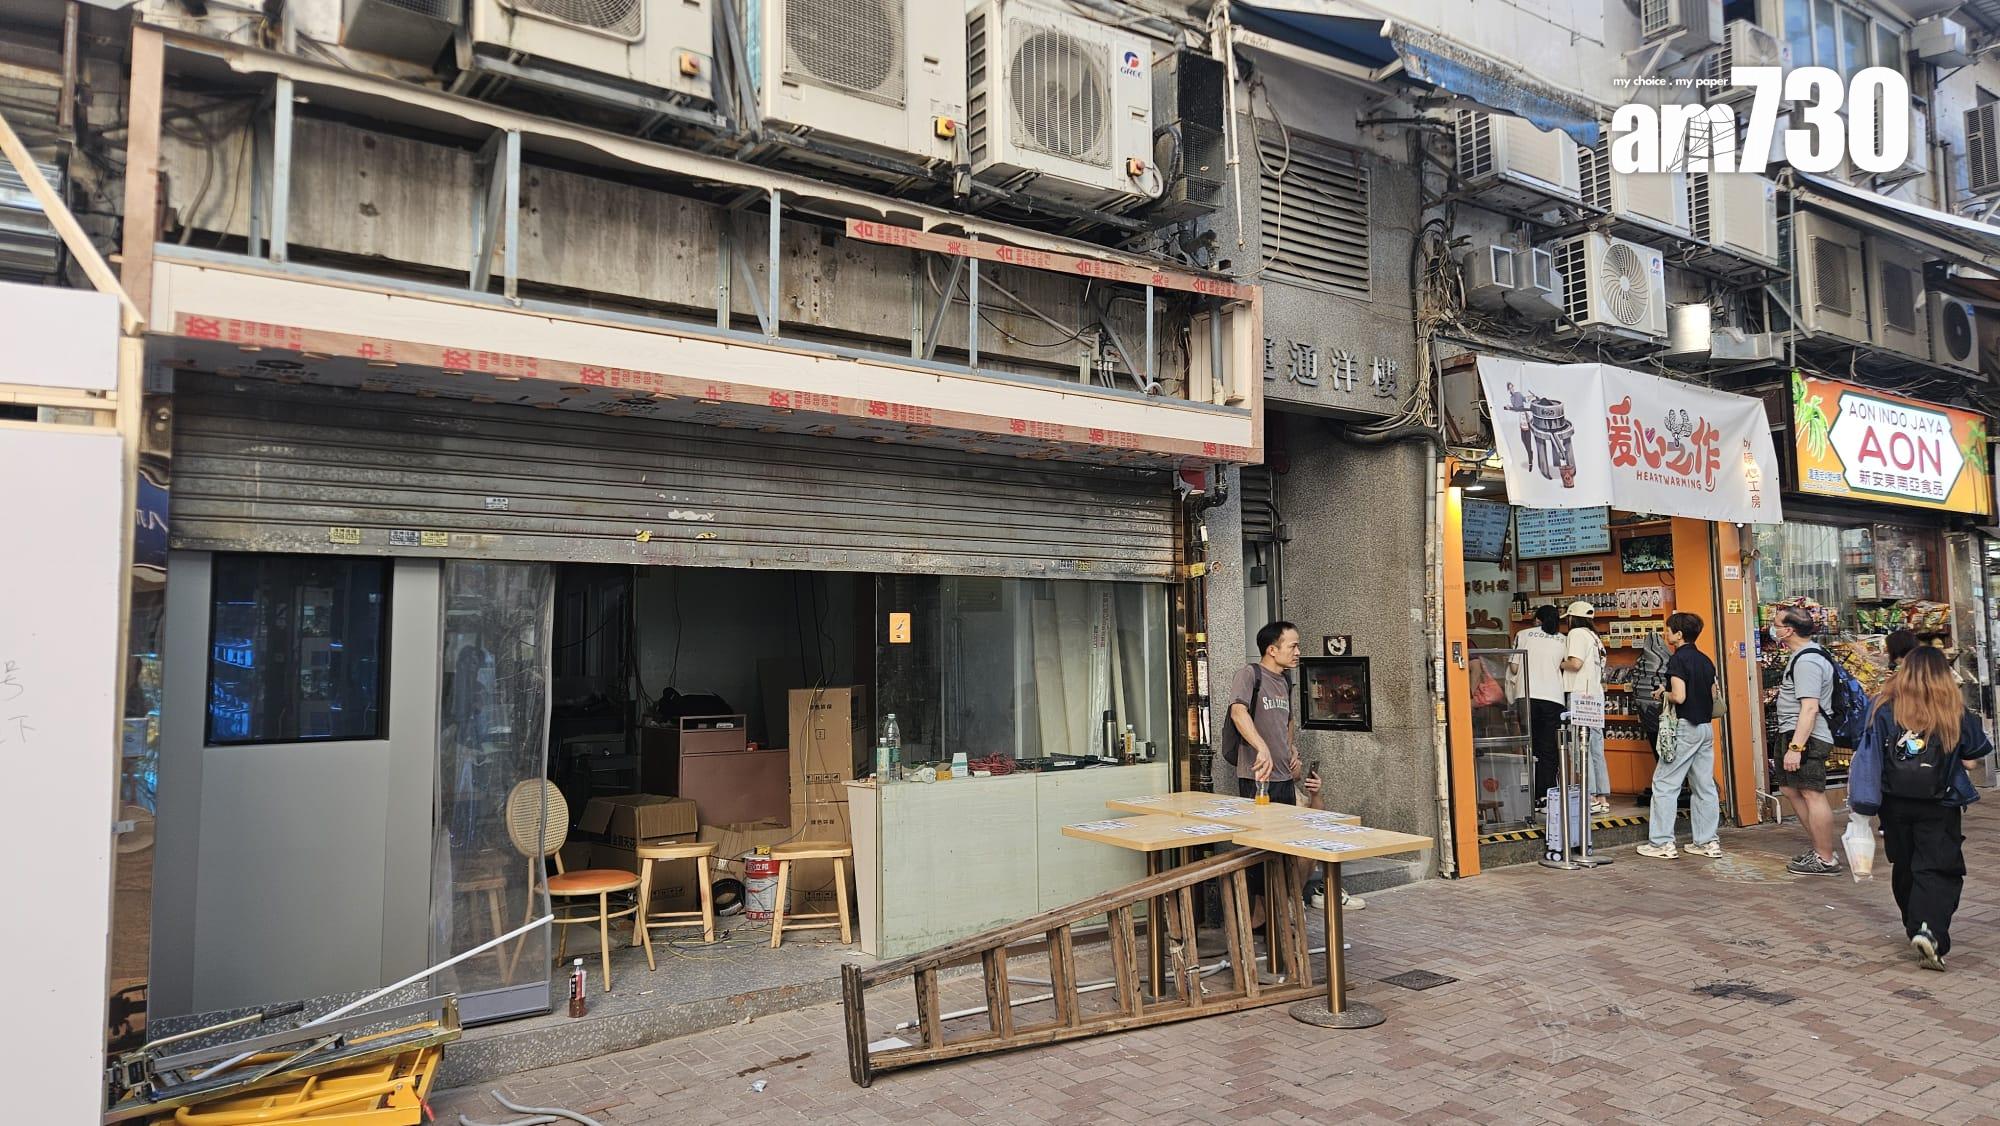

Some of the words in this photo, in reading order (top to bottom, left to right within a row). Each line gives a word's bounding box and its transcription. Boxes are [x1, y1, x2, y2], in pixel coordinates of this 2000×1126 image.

[1849, 402, 1876, 420] AON
[1879, 407, 1908, 428] INDO
[1912, 416, 1944, 436] JAYA
[1858, 426, 1942, 477] AON
[1636, 471, 1702, 490] HEARTWARMING
[1859, 470, 1944, 496] 新安東南亞食品
